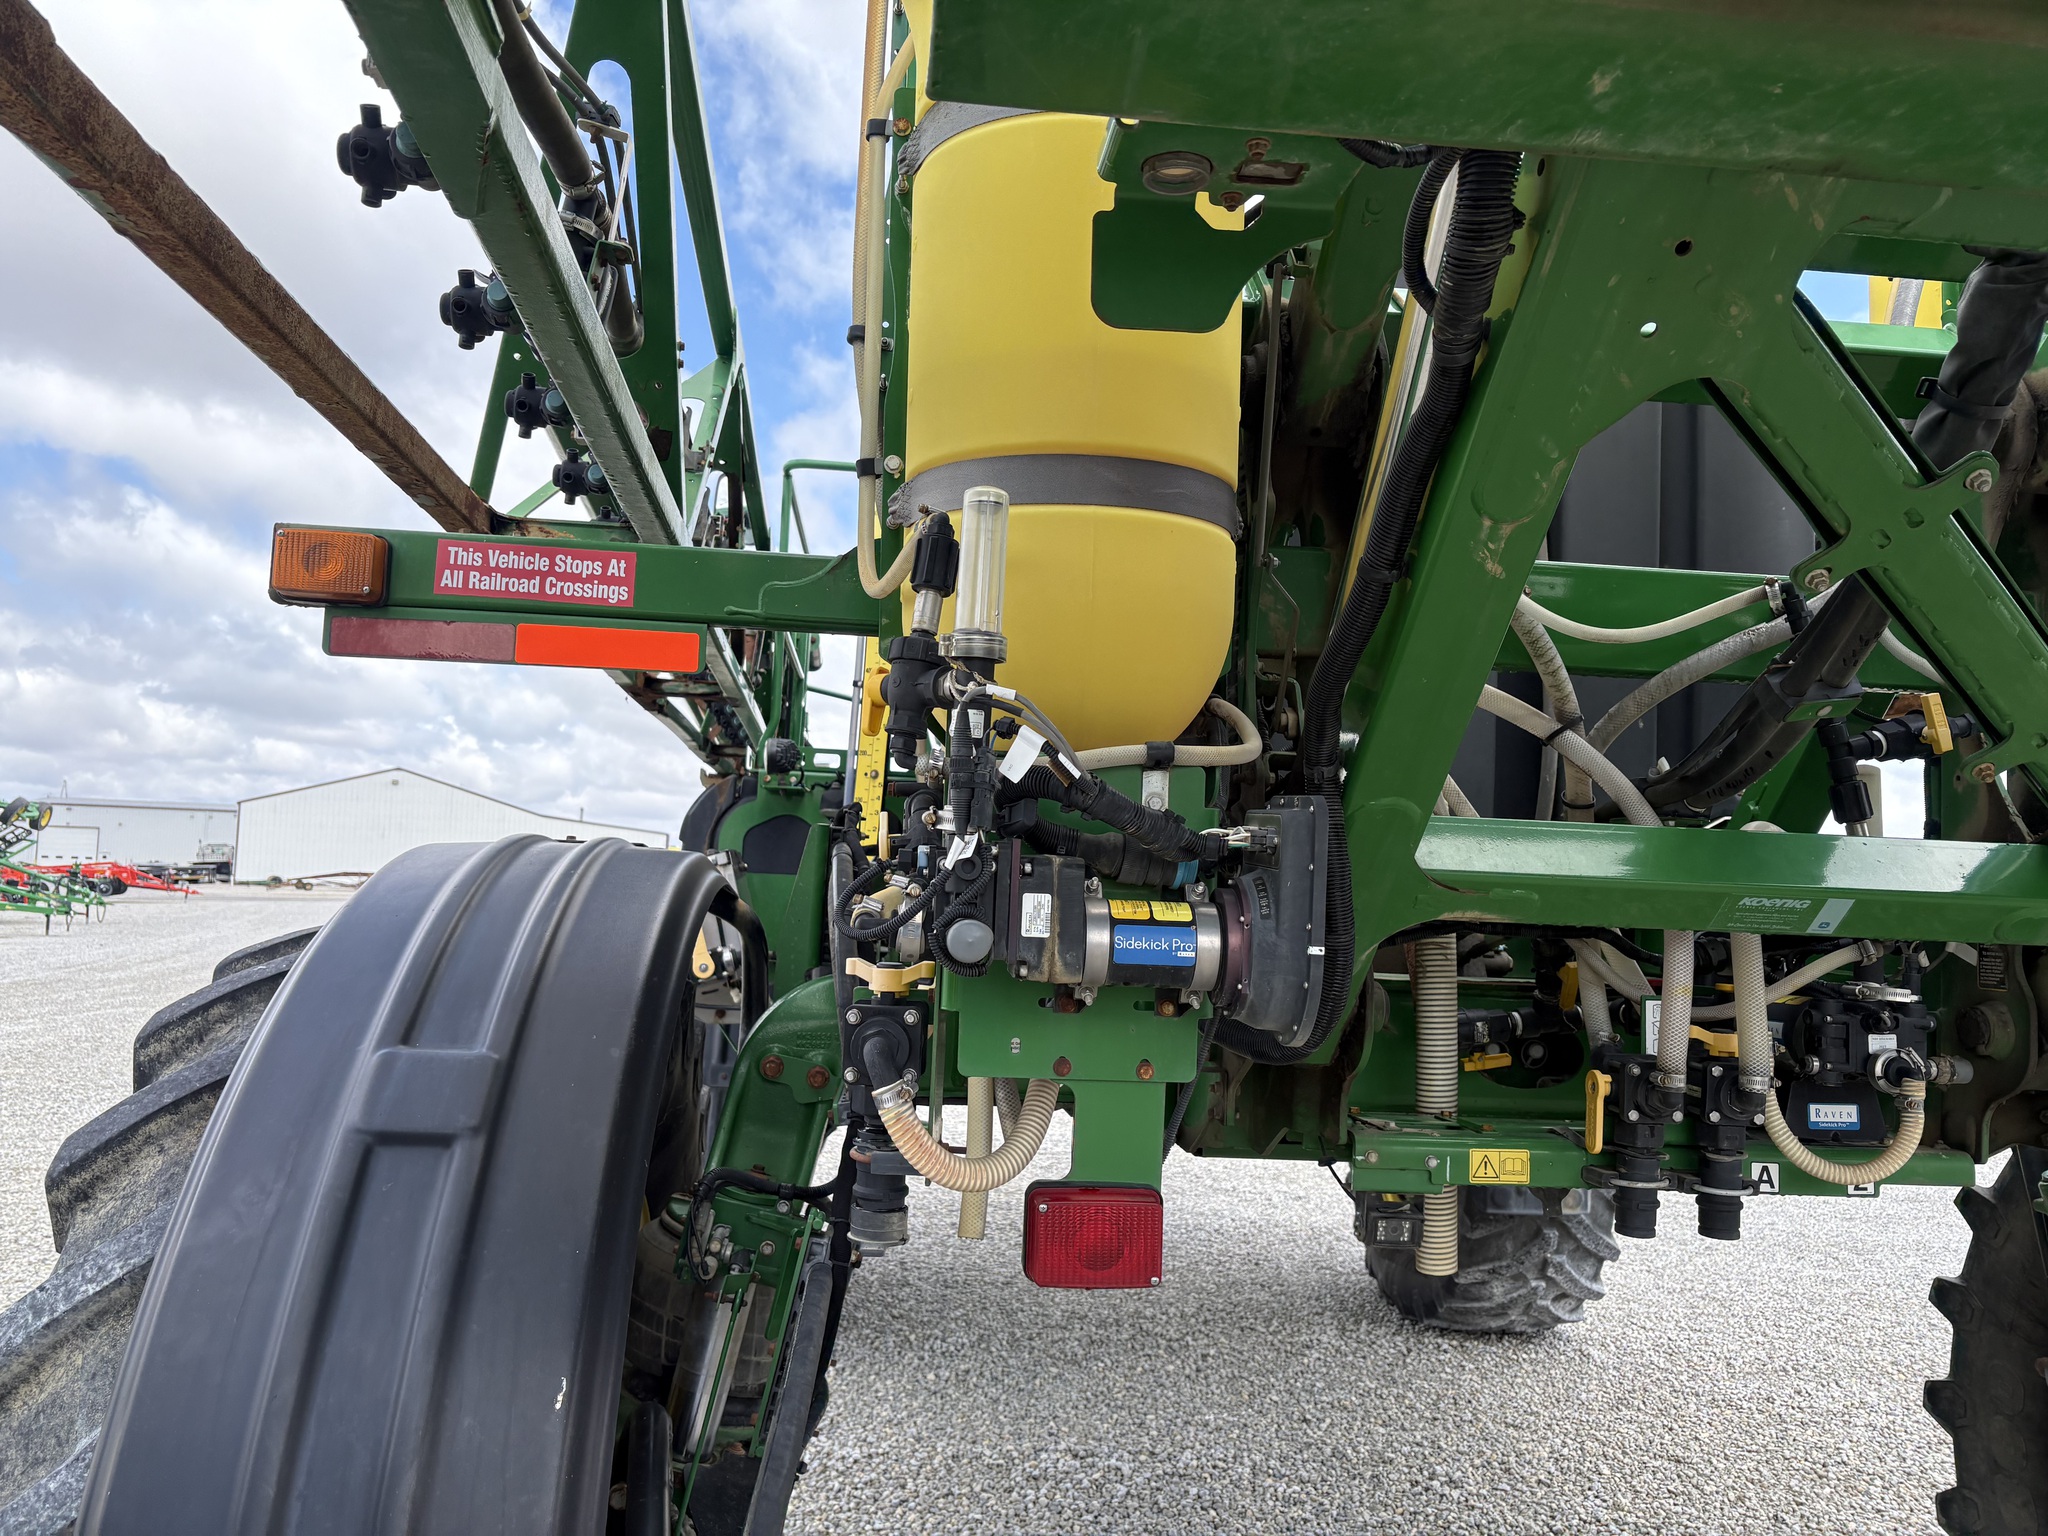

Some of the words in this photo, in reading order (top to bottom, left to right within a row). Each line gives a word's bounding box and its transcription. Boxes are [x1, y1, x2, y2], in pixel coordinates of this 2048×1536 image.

[448, 546, 483, 567] This
[488, 549, 550, 572] Vehicle
[554, 553, 602, 578] Stops
[607, 559, 627, 577] At
[440, 569, 463, 588] All
[468, 571, 540, 594] Railroad
[545, 576, 629, 604] Crossings
[1114, 935, 1169, 951] Sidekick
[1815, 1107, 1852, 1119] RAVEN
[1757, 1165, 1775, 1189] A
